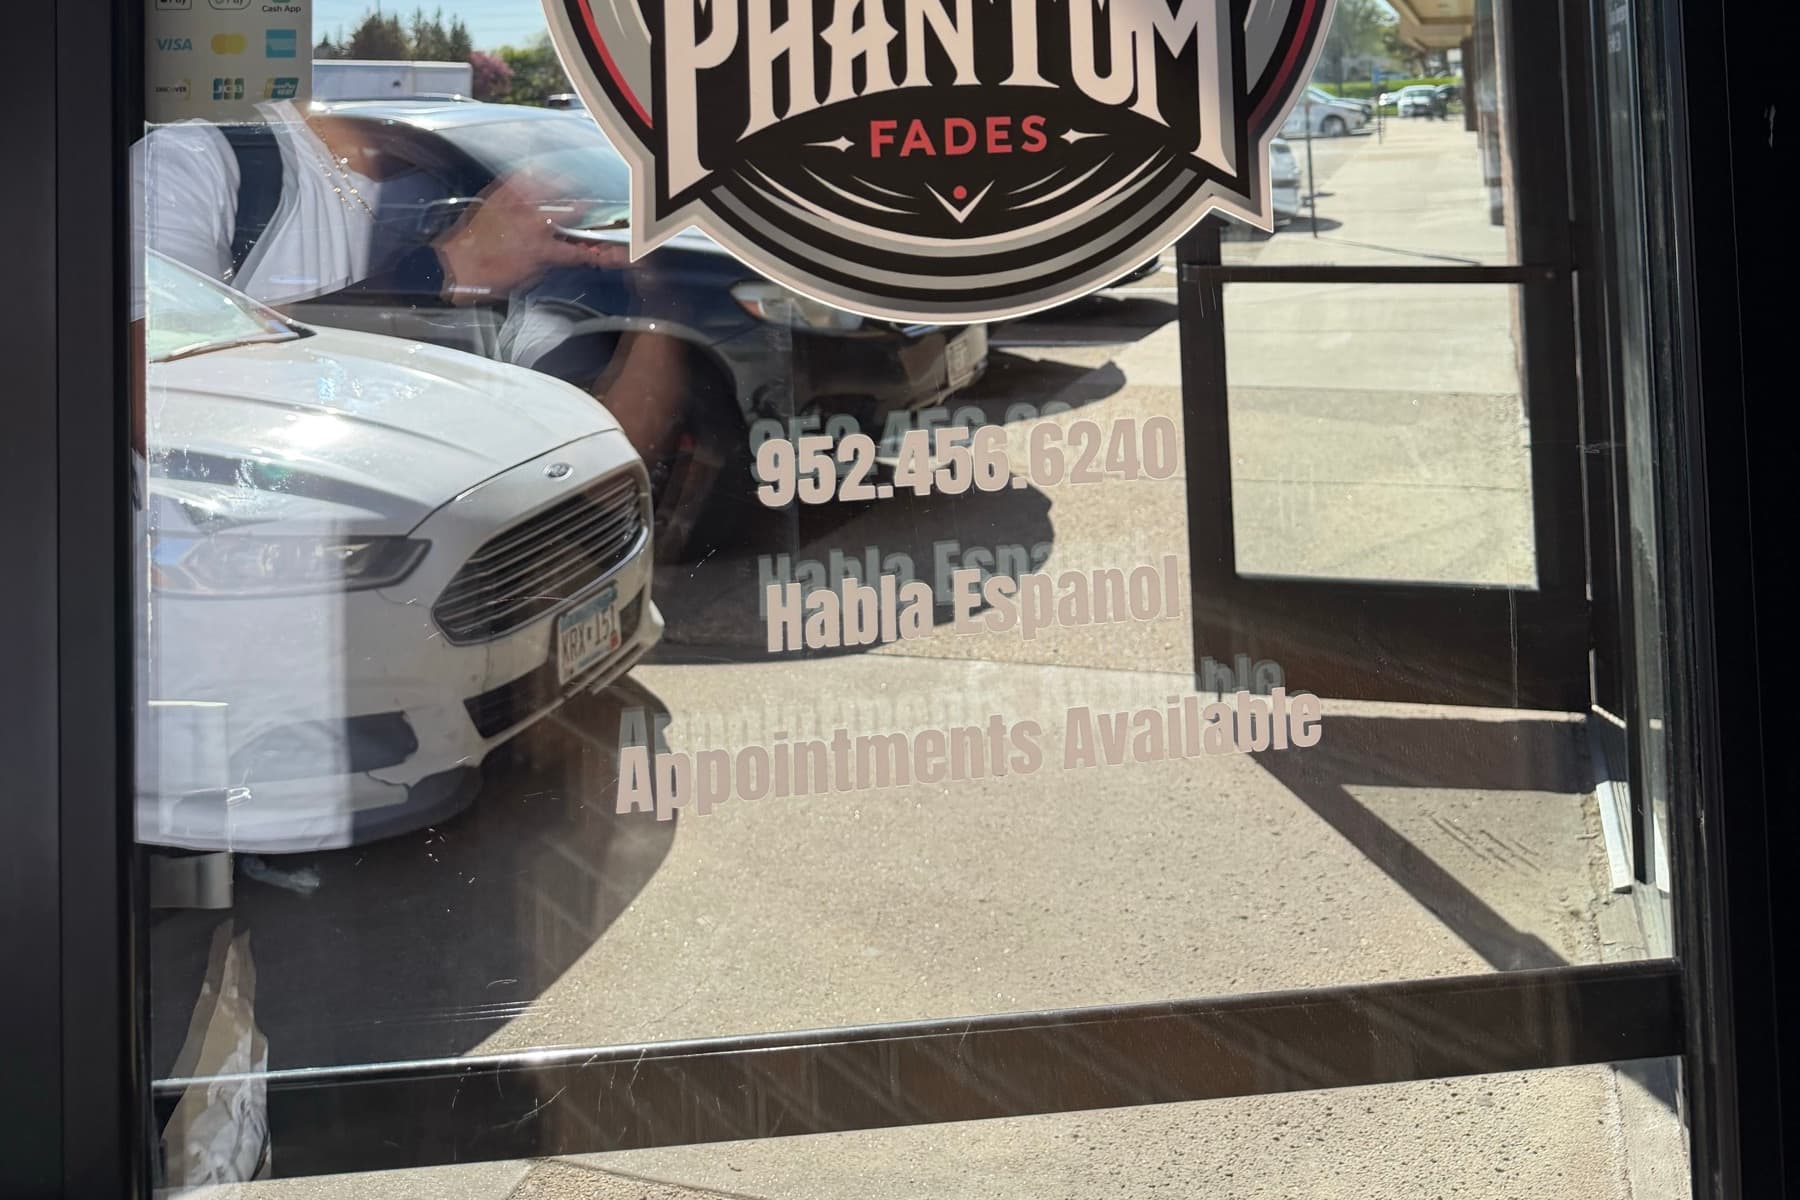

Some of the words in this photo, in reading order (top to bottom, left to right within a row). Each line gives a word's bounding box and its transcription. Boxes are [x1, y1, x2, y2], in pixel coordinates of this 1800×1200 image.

[262, 5, 282, 13] Cash
[284, 5, 301, 13] App
[156, 38, 193, 51] VISA
[870, 115, 1048, 158] FADES
[756, 415, 1178, 507] 952.456.6240
[766, 574, 935, 653] Habla
[952, 554, 1181, 641] Espanol
[615, 713, 1044, 822] Appointments
[1063, 686, 1323, 771] Available
